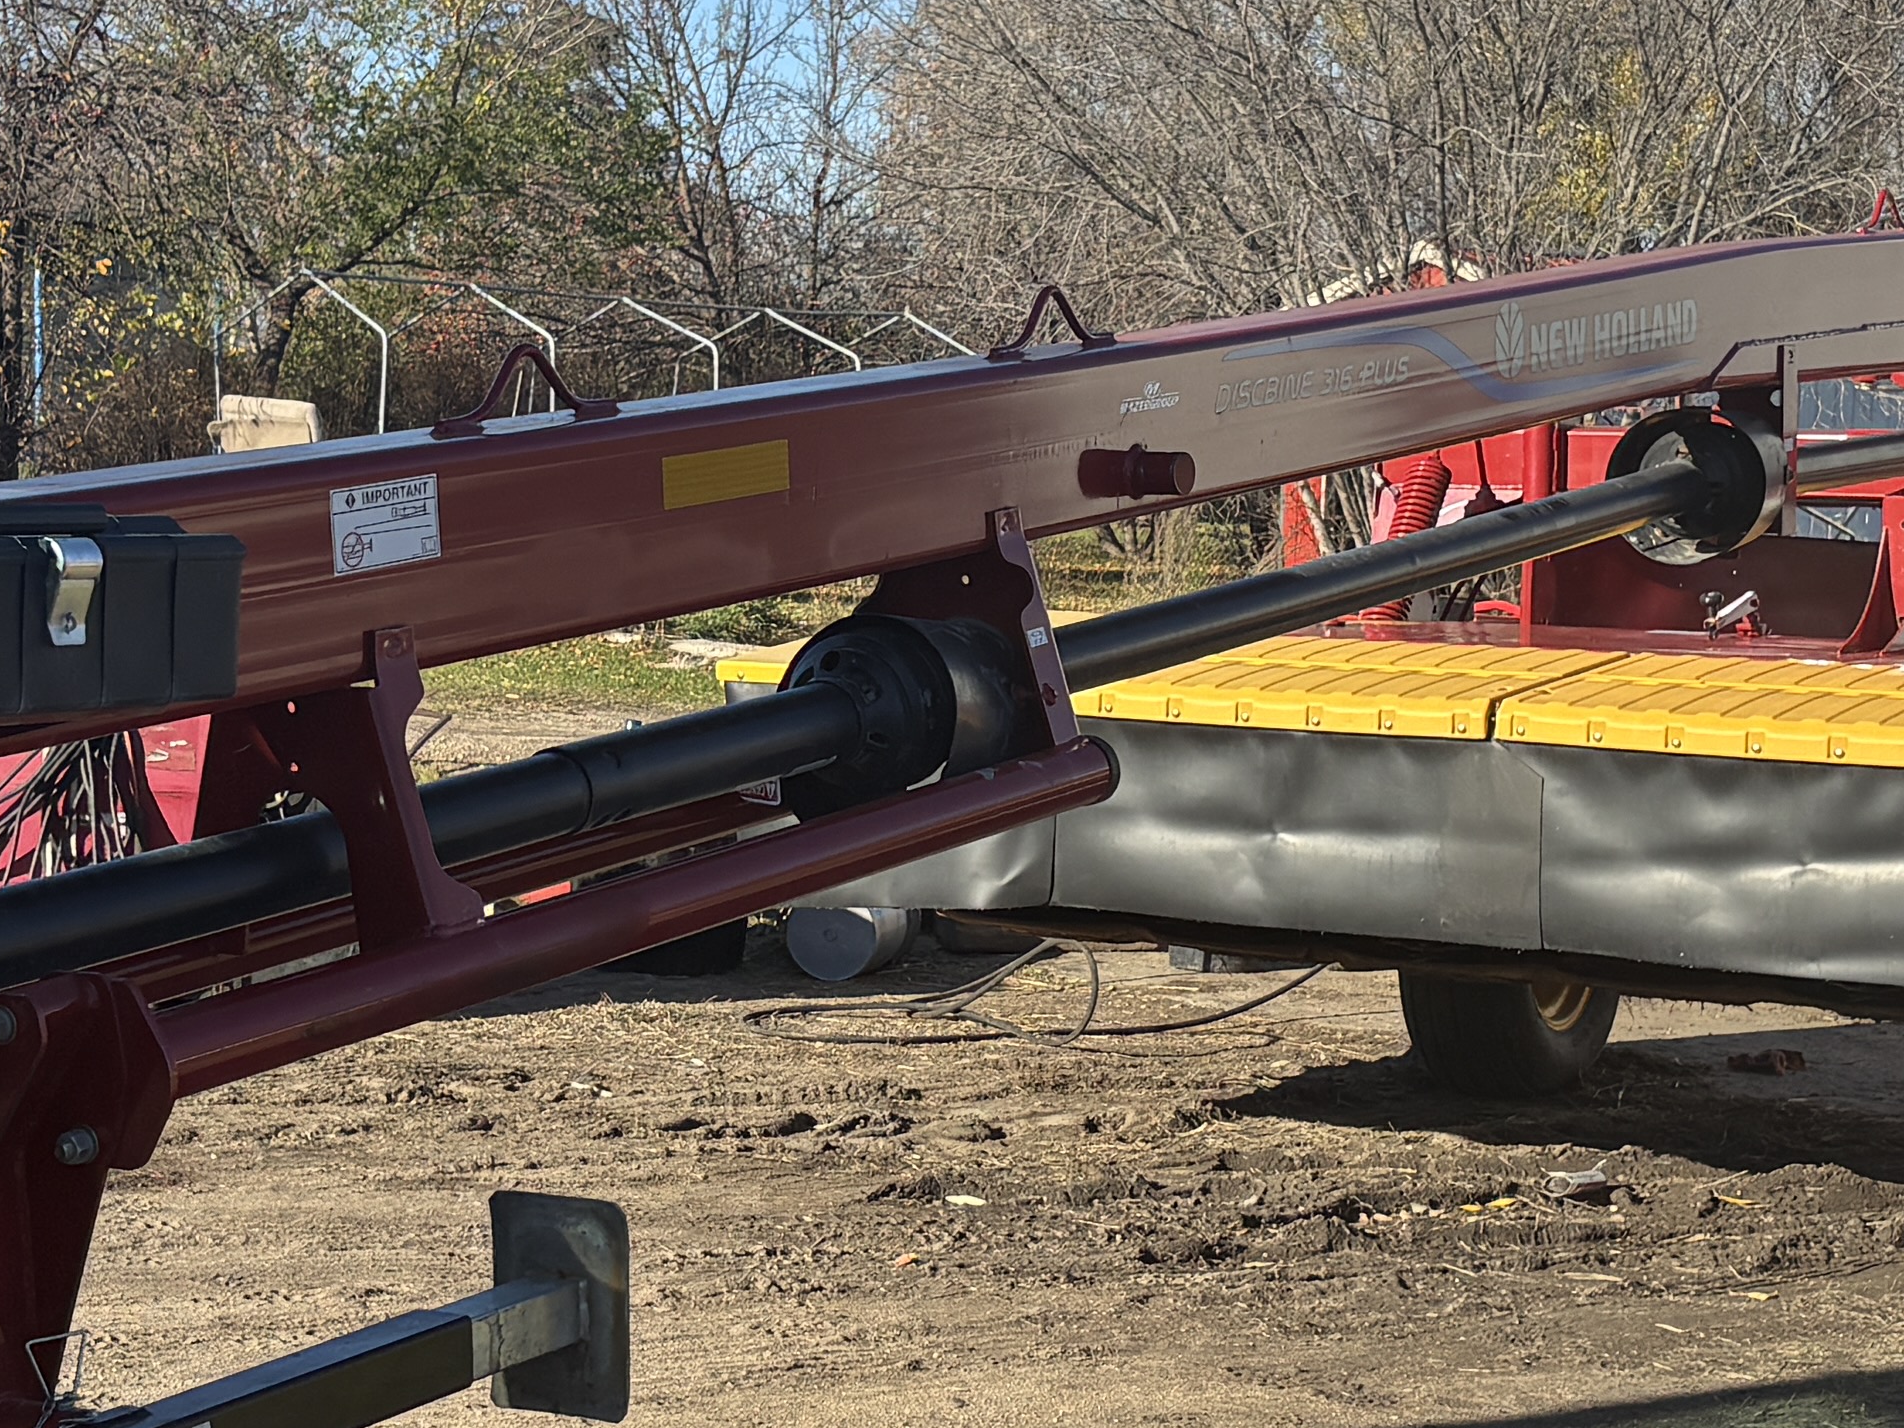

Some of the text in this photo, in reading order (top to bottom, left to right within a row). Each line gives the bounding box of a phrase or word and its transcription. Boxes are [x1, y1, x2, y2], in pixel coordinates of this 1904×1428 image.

[1530, 299, 1697, 373] NEW HOLLAND
[1215, 371, 1315, 414] DISCBINE
[1319, 364, 1353, 396] 316
[362, 482, 428, 505] IMPORTANT
